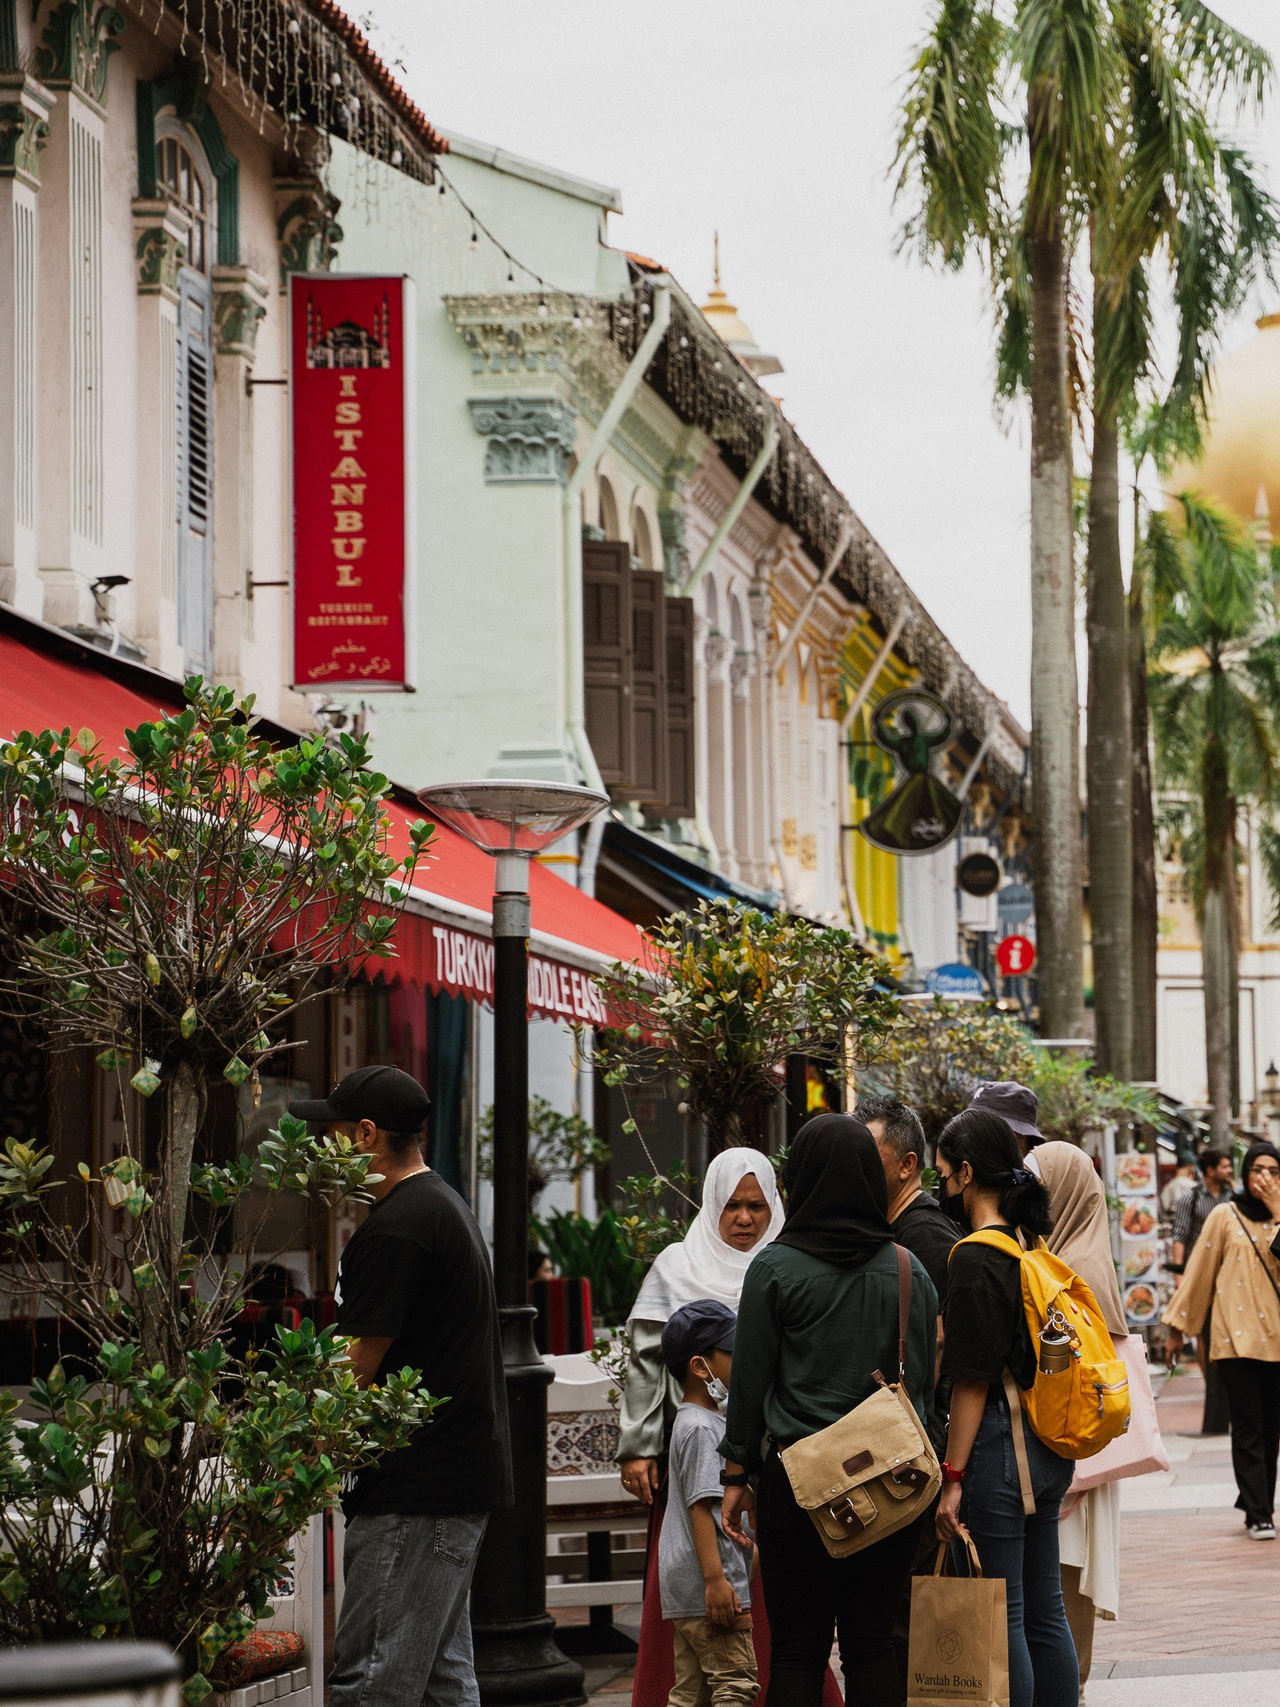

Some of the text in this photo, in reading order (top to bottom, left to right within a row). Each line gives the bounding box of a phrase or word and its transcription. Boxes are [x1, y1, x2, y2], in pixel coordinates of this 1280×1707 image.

[330, 375, 367, 587] ISTANBUL
[308, 615, 389, 626] RESTAURANT
[331, 638, 367, 659] مطعم
[433, 926, 495, 994] TURKIY
[914, 1673, 983, 1688] Wardah Books
